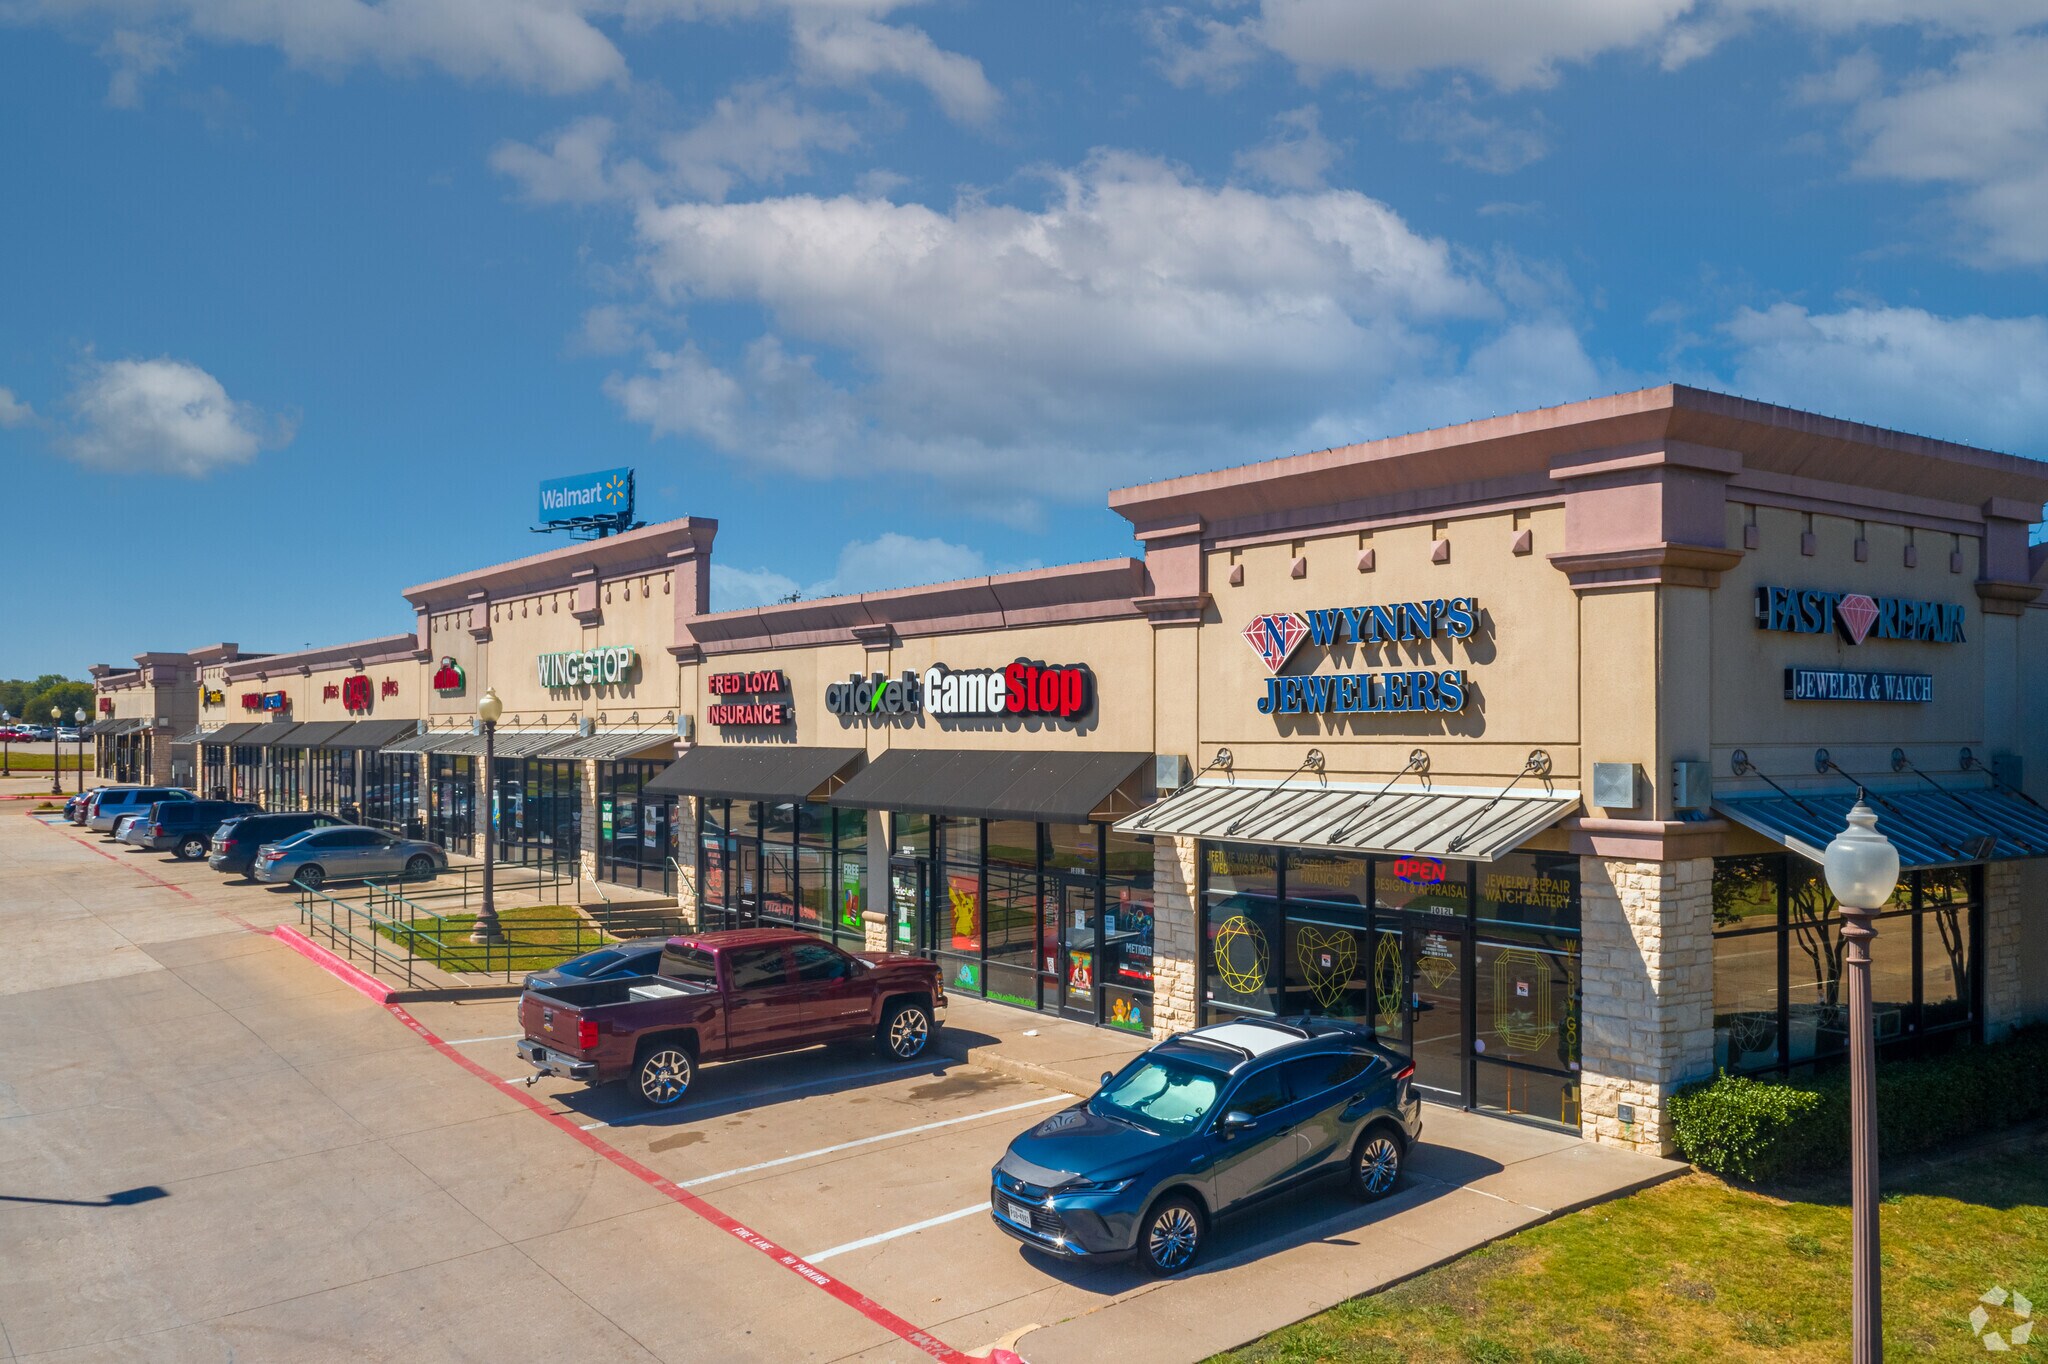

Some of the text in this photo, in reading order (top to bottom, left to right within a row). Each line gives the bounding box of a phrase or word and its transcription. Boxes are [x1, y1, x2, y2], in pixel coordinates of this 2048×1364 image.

[542, 482, 602, 510] Walmart
[1305, 597, 1474, 647] WYNN'S
[1767, 586, 1967, 643] FAST REPAIR
[708, 672, 779, 694] FRED LOYA
[825, 671, 915, 714] cricket
[924, 662, 1082, 716] GameStop
[1257, 669, 1468, 715] JEWELERS
[1796, 671, 1933, 701] JEWELRY & WATCH
[707, 704, 781, 724] INSURANCE
[843, 863, 859, 876] FREE
[1301, 870, 1350, 887] FINANCING
[1334, 861, 1365, 876] CHECK
[1394, 859, 1446, 881] OPEN
[1375, 877, 1407, 892] DESIGN
[1418, 883, 1467, 899] APPRAISAL
[1485, 874, 1570, 893] JEWELRY REPAIR
[1485, 888, 1570, 908] WATCH BATTERY
[1126, 942, 1152, 956] METROID
[731, 1227, 830, 1285] FIRE LANE NO PARKING
